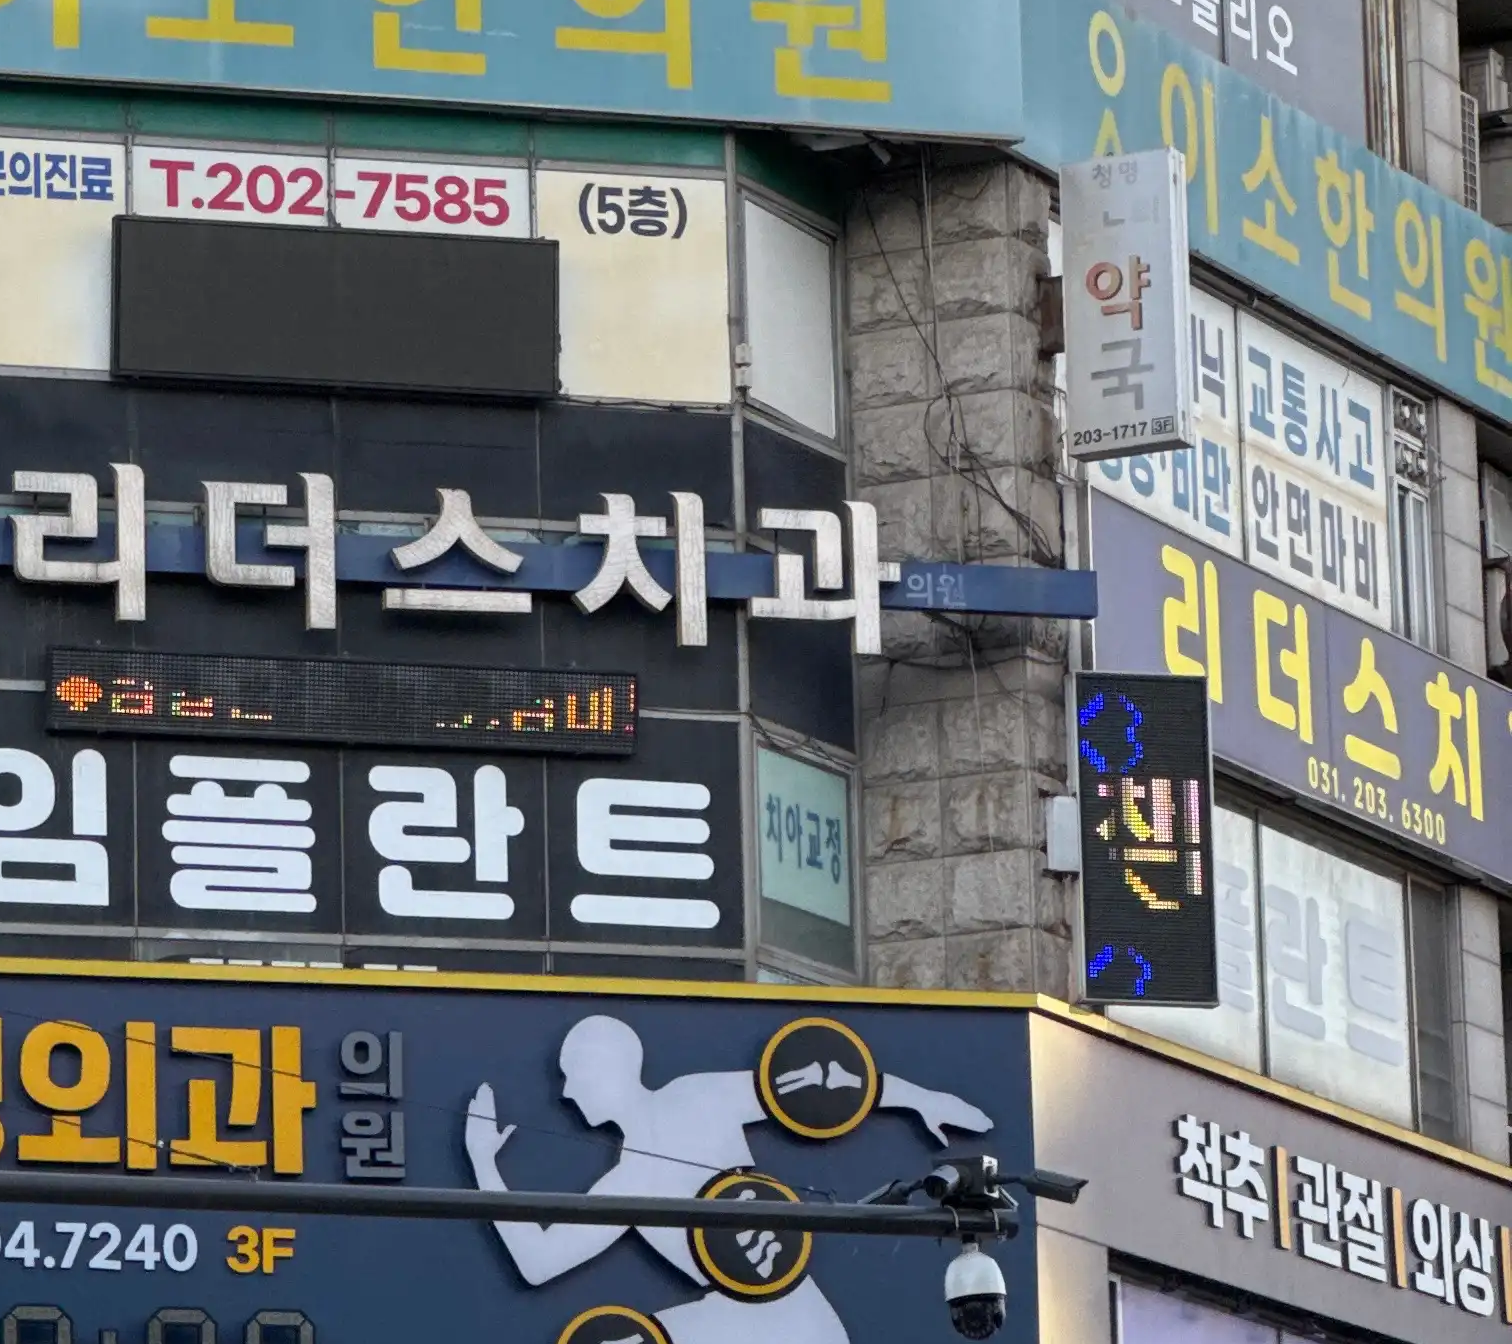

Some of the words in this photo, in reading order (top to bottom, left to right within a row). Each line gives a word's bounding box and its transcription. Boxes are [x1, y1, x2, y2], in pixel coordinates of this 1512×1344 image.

[148, 156, 514, 232] T.202-7585
[576, 177, 690, 241] (5층)
[1084, 255, 1156, 412] 약국
[1072, 421, 1149, 448] 203-1717
[1153, 418, 1174, 437] 3F
[1247, 345, 1376, 492] 교통사고
[8, 462, 902, 656] 리더스치과
[1251, 464, 1380, 611] 안면마비
[764, 791, 844, 887] 치아교정
[225, 1225, 298, 1276] 3F
[1176, 1114, 1271, 1240] 척추
[1294, 1154, 1389, 1285] 관절
[1410, 1196, 1495, 1318] 외상
